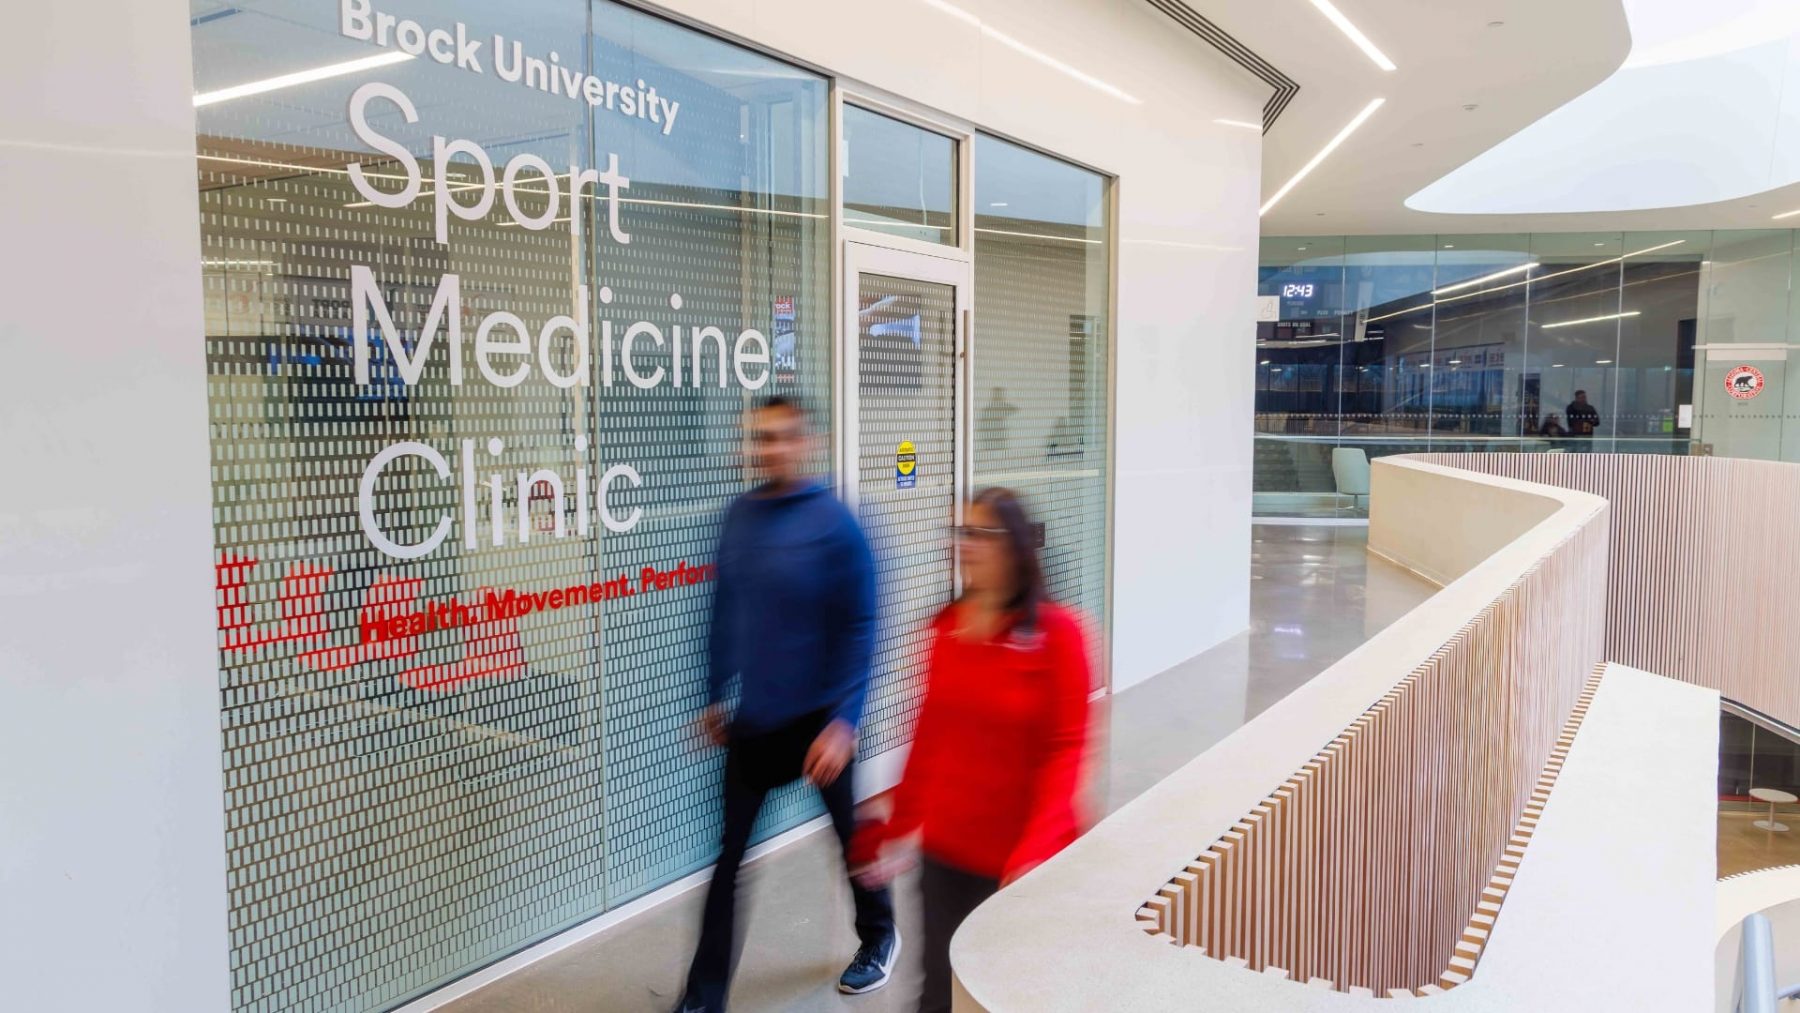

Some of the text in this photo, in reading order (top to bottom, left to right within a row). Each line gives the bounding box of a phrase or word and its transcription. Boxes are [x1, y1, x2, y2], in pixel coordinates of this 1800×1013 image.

[342, 0, 680, 136] Brock University
[347, 82, 631, 245] Sport
[350, 264, 769, 390] Medicine
[1283, 284, 1313, 298] 12:43
[358, 436, 643, 559] Clinic
[360, 597, 477, 645] Health.
[486, 574, 636, 618] Movement.
